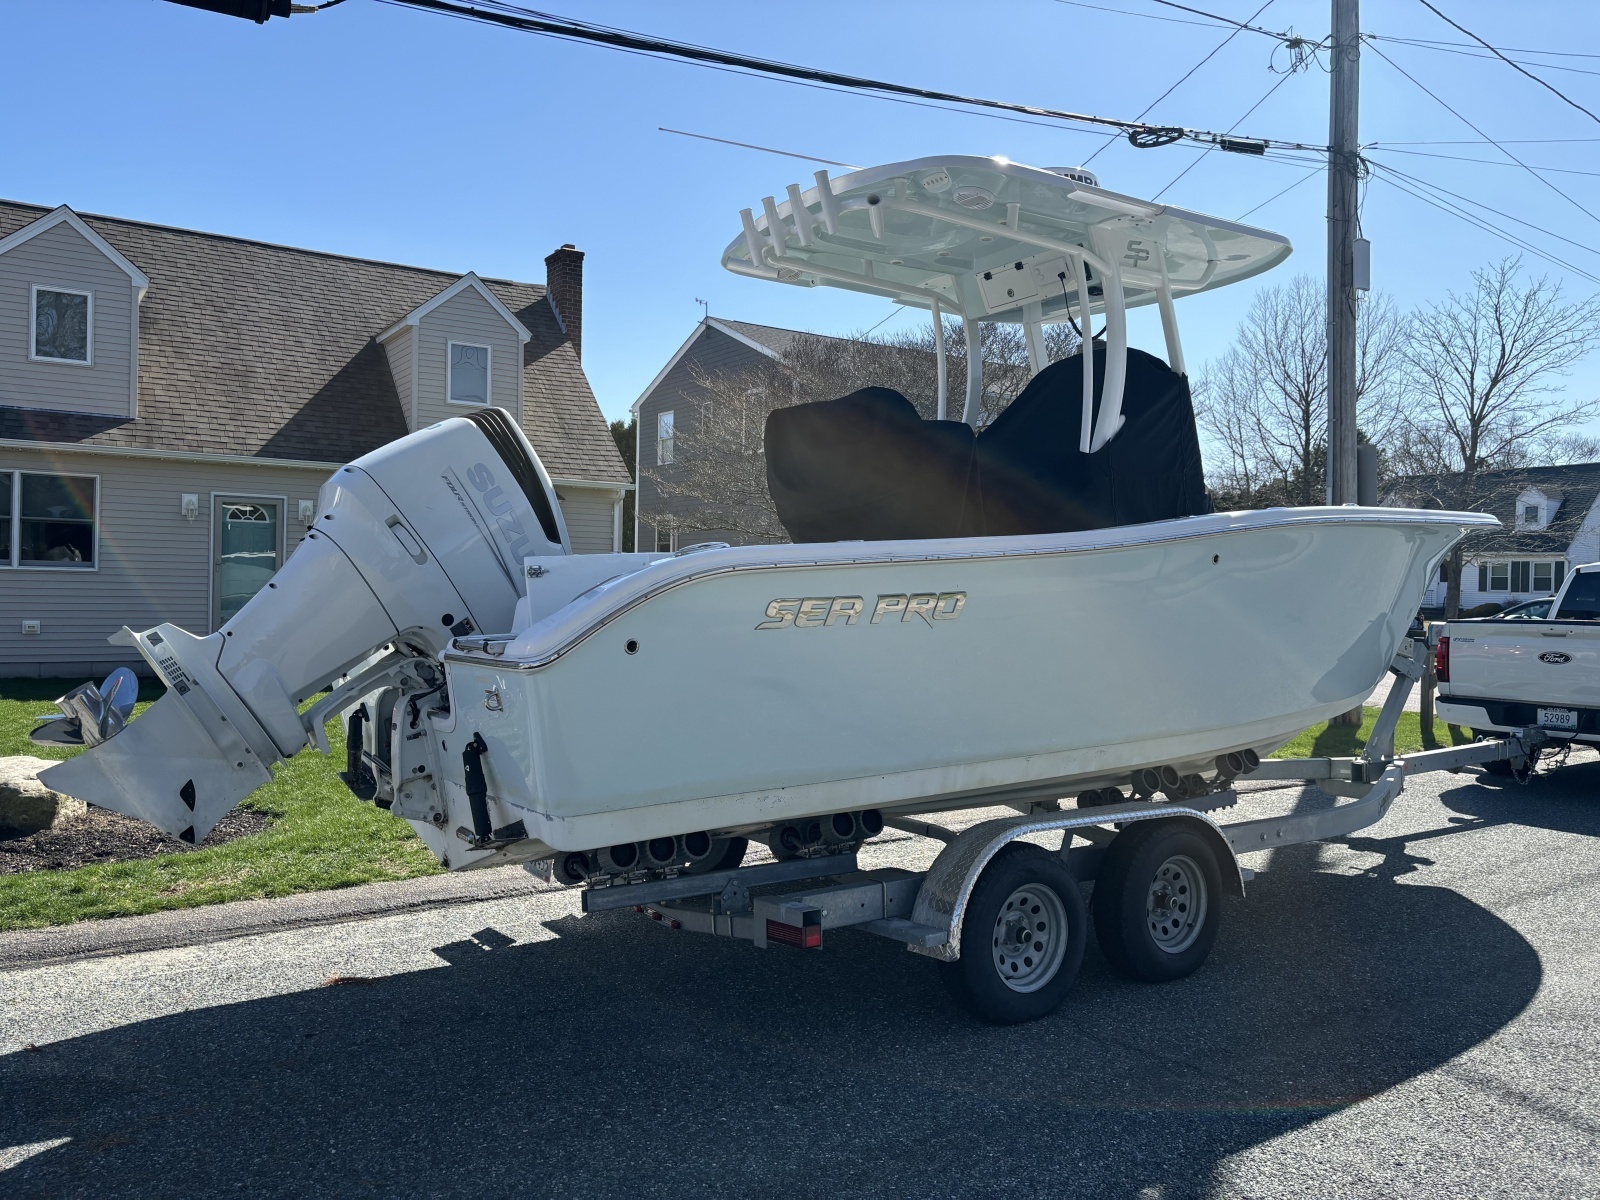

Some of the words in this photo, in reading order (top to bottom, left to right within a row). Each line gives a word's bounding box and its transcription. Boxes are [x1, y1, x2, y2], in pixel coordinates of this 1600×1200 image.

[466, 462, 535, 577] SUZU
[754, 595, 864, 630] SEA
[870, 590, 967, 629] PRO
[1543, 653, 1565, 663] Ford
[1544, 712, 1570, 724] 52989
